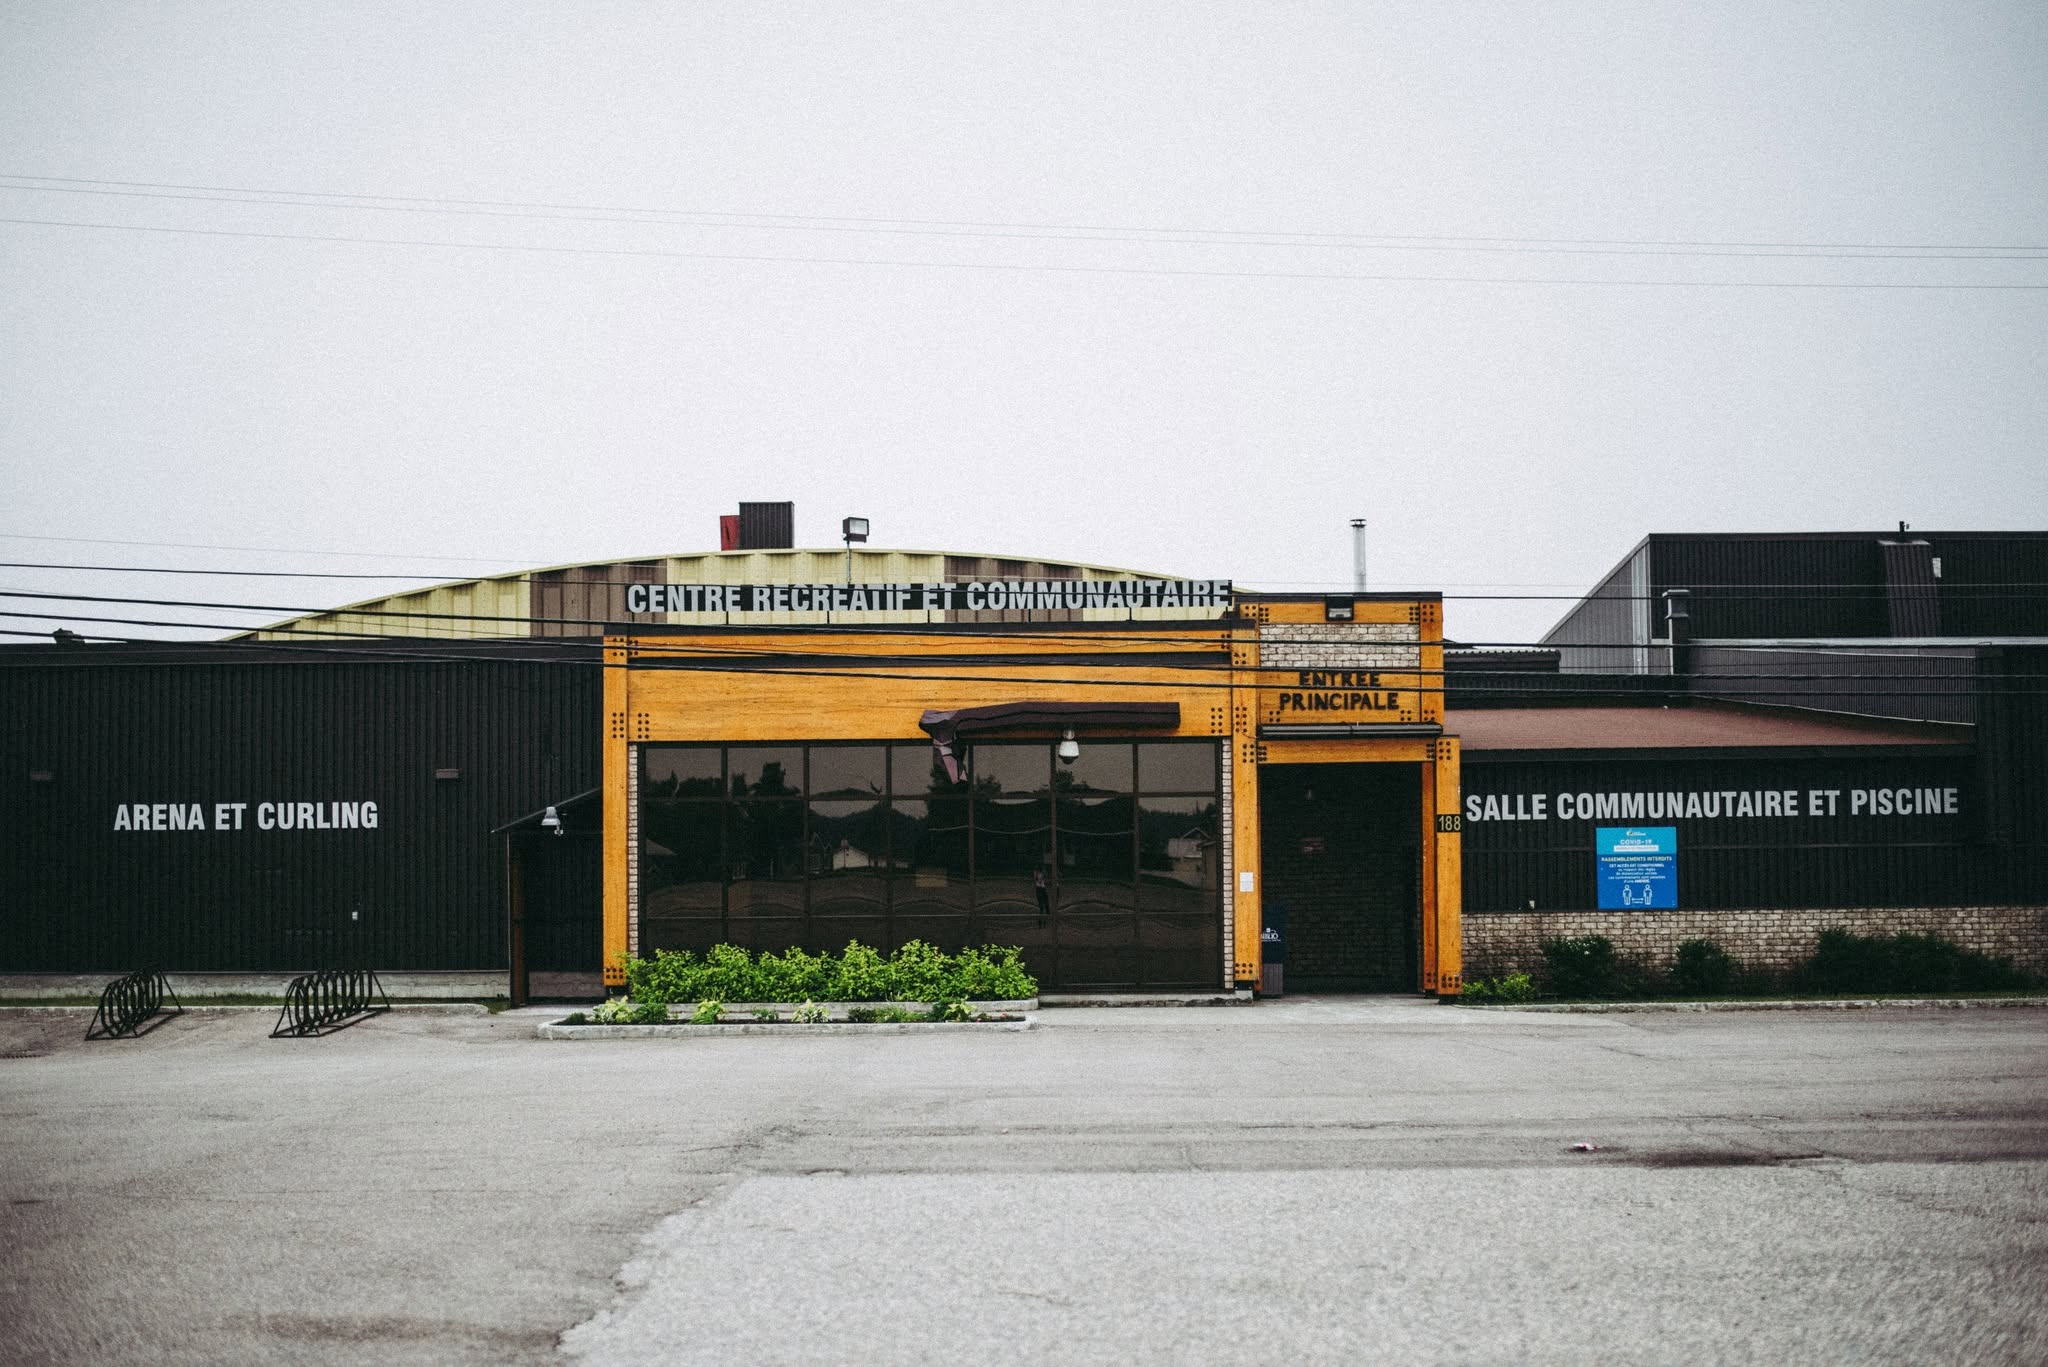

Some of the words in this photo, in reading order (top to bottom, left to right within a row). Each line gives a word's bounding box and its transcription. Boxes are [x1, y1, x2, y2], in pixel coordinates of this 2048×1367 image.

[627, 584, 741, 613] CENTRE
[752, 584, 911, 612] RECREATIF
[922, 583, 957, 610] ET
[966, 580, 1229, 610] COMMUNAUTAIRE
[1279, 692, 1400, 711] PRINCIPALE
[113, 804, 206, 831] ARENA
[215, 803, 247, 831] ET
[257, 801, 379, 831] CURLING
[1466, 794, 1548, 822] SALLE
[1556, 790, 1799, 821] COMMUNAUTAIRE
[1808, 790, 1841, 817] ET
[1851, 787, 1959, 815] PISCINE
[1438, 815, 1461, 832] 188
